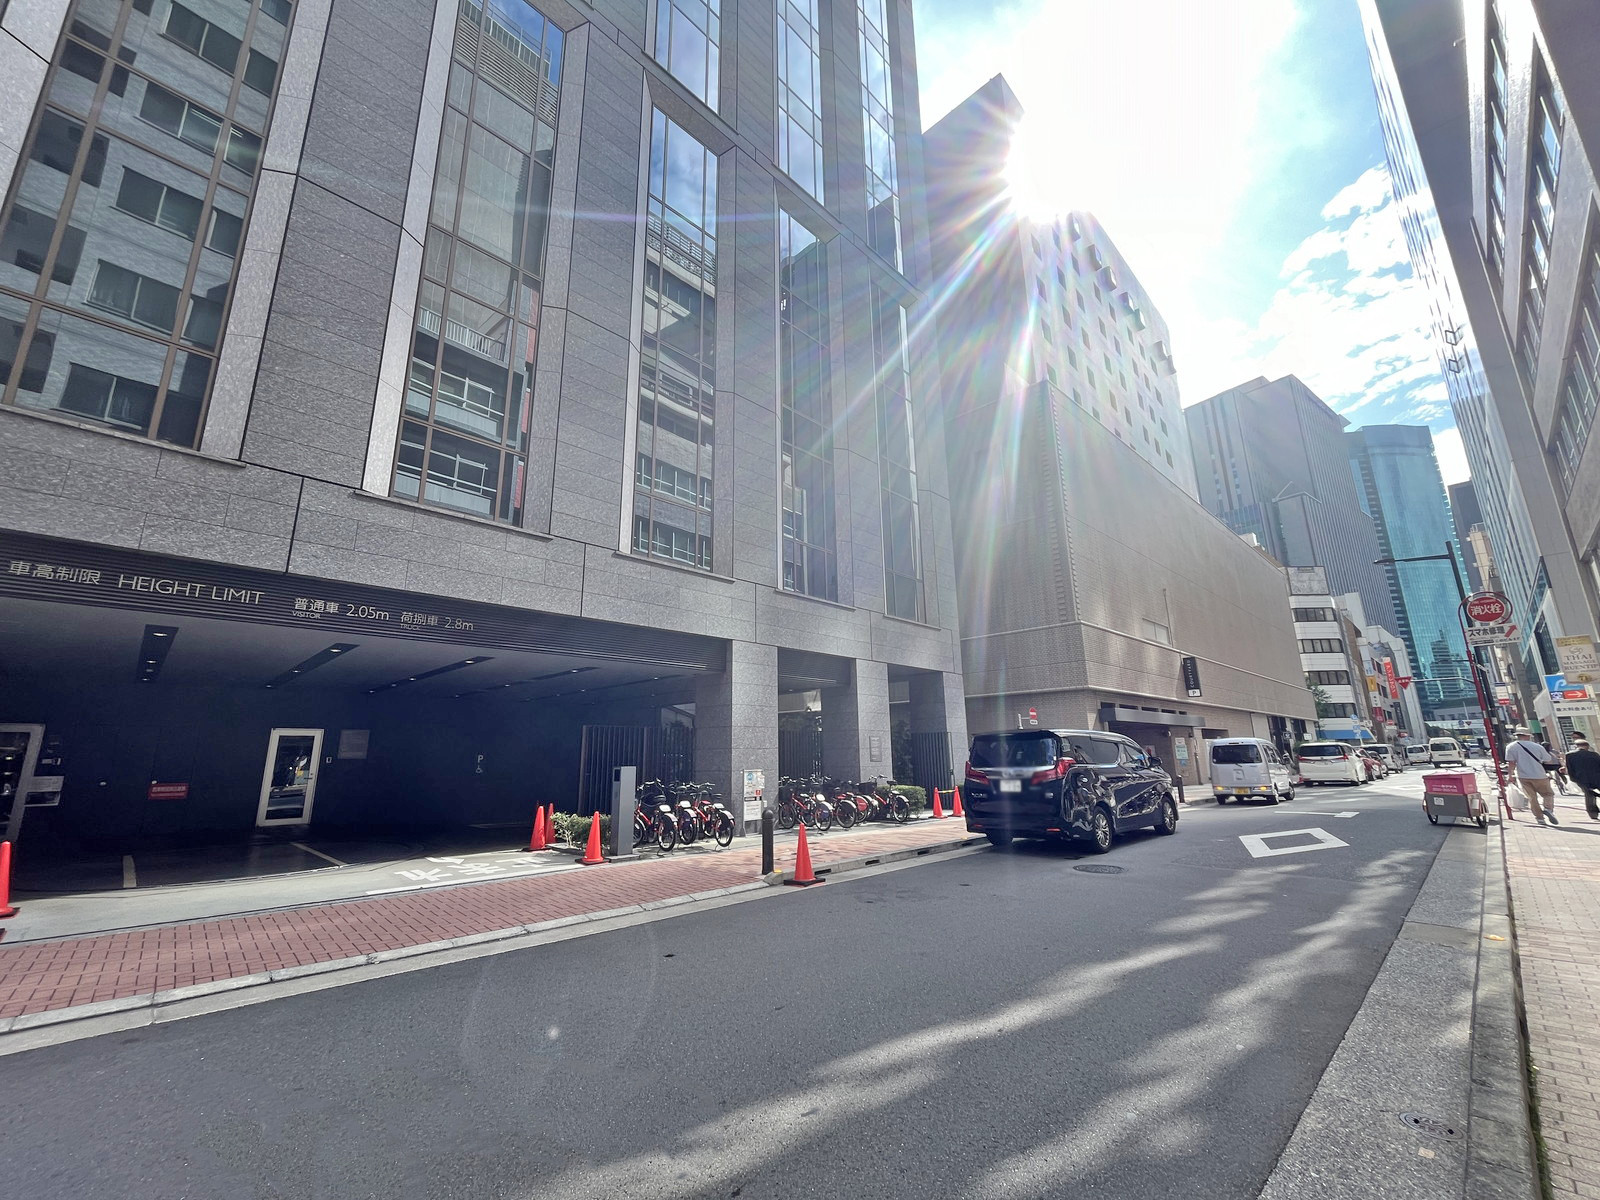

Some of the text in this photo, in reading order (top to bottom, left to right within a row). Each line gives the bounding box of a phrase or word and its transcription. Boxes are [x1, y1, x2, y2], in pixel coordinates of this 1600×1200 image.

[8, 561, 101, 585] 車高制限
[118, 574, 265, 604] HEIGHT LIMIT
[292, 611, 321, 619] VISITOR
[294, 598, 474, 631] 普通車 2.05m 荷捌車 2.8m
[1470, 603, 1502, 616] 消火栓
[478, 755, 484, 763] P
